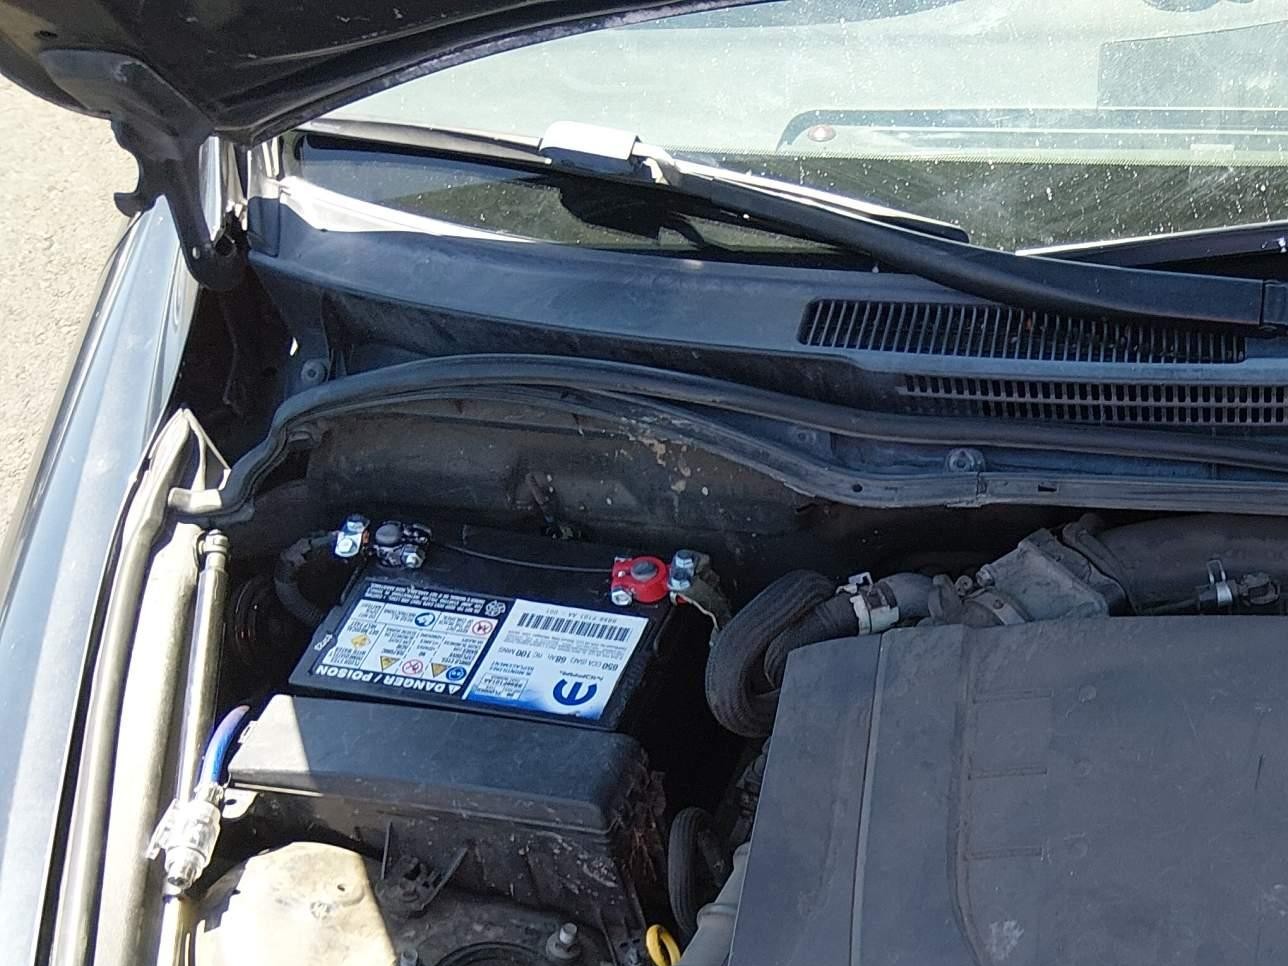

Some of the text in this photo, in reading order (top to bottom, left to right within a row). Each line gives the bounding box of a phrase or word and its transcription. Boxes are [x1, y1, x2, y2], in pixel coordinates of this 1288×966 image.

[514, 649, 532, 658] 100
[315, 664, 374, 681] POISON
[600, 661, 619, 671] 650
[381, 674, 447, 692] DANGER
